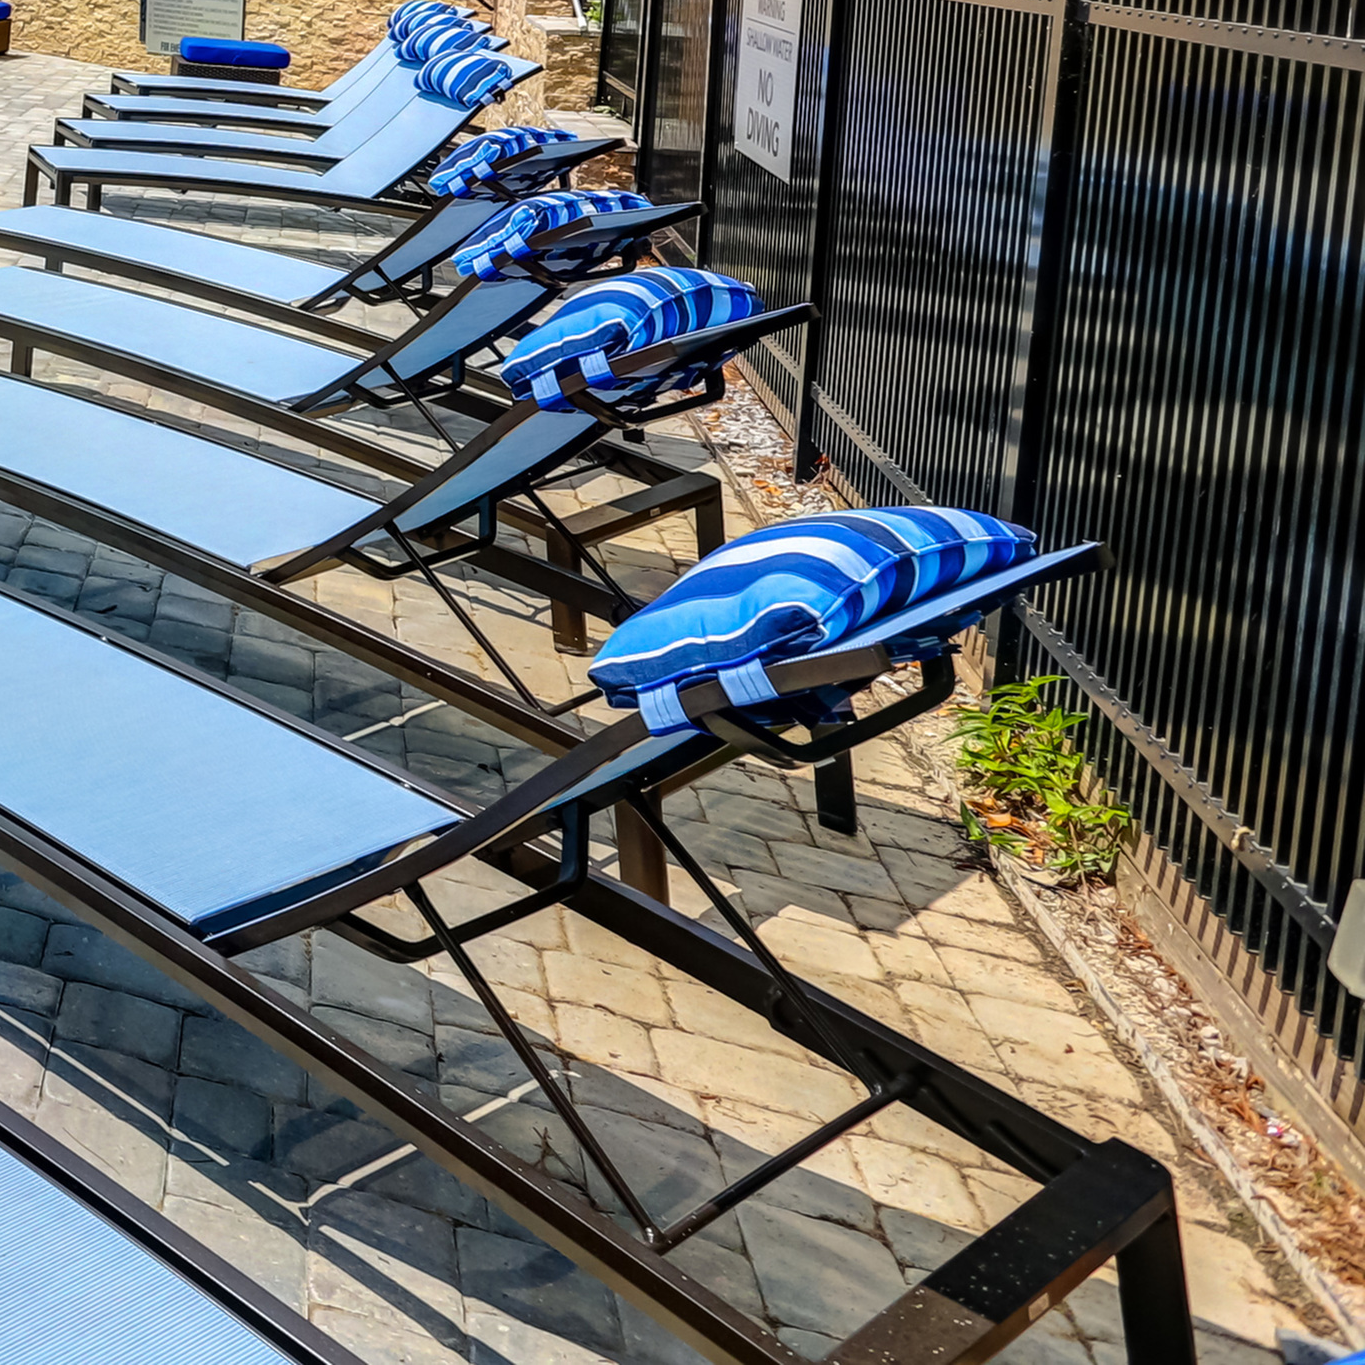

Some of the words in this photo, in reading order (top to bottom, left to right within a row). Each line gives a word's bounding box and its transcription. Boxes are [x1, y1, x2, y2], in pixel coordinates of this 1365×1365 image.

[746, 27, 772, 54] SHALLOW
[772, 36, 793, 63] WATER
[758, 68, 774, 107] NO
[746, 106, 780, 158] DIVING
